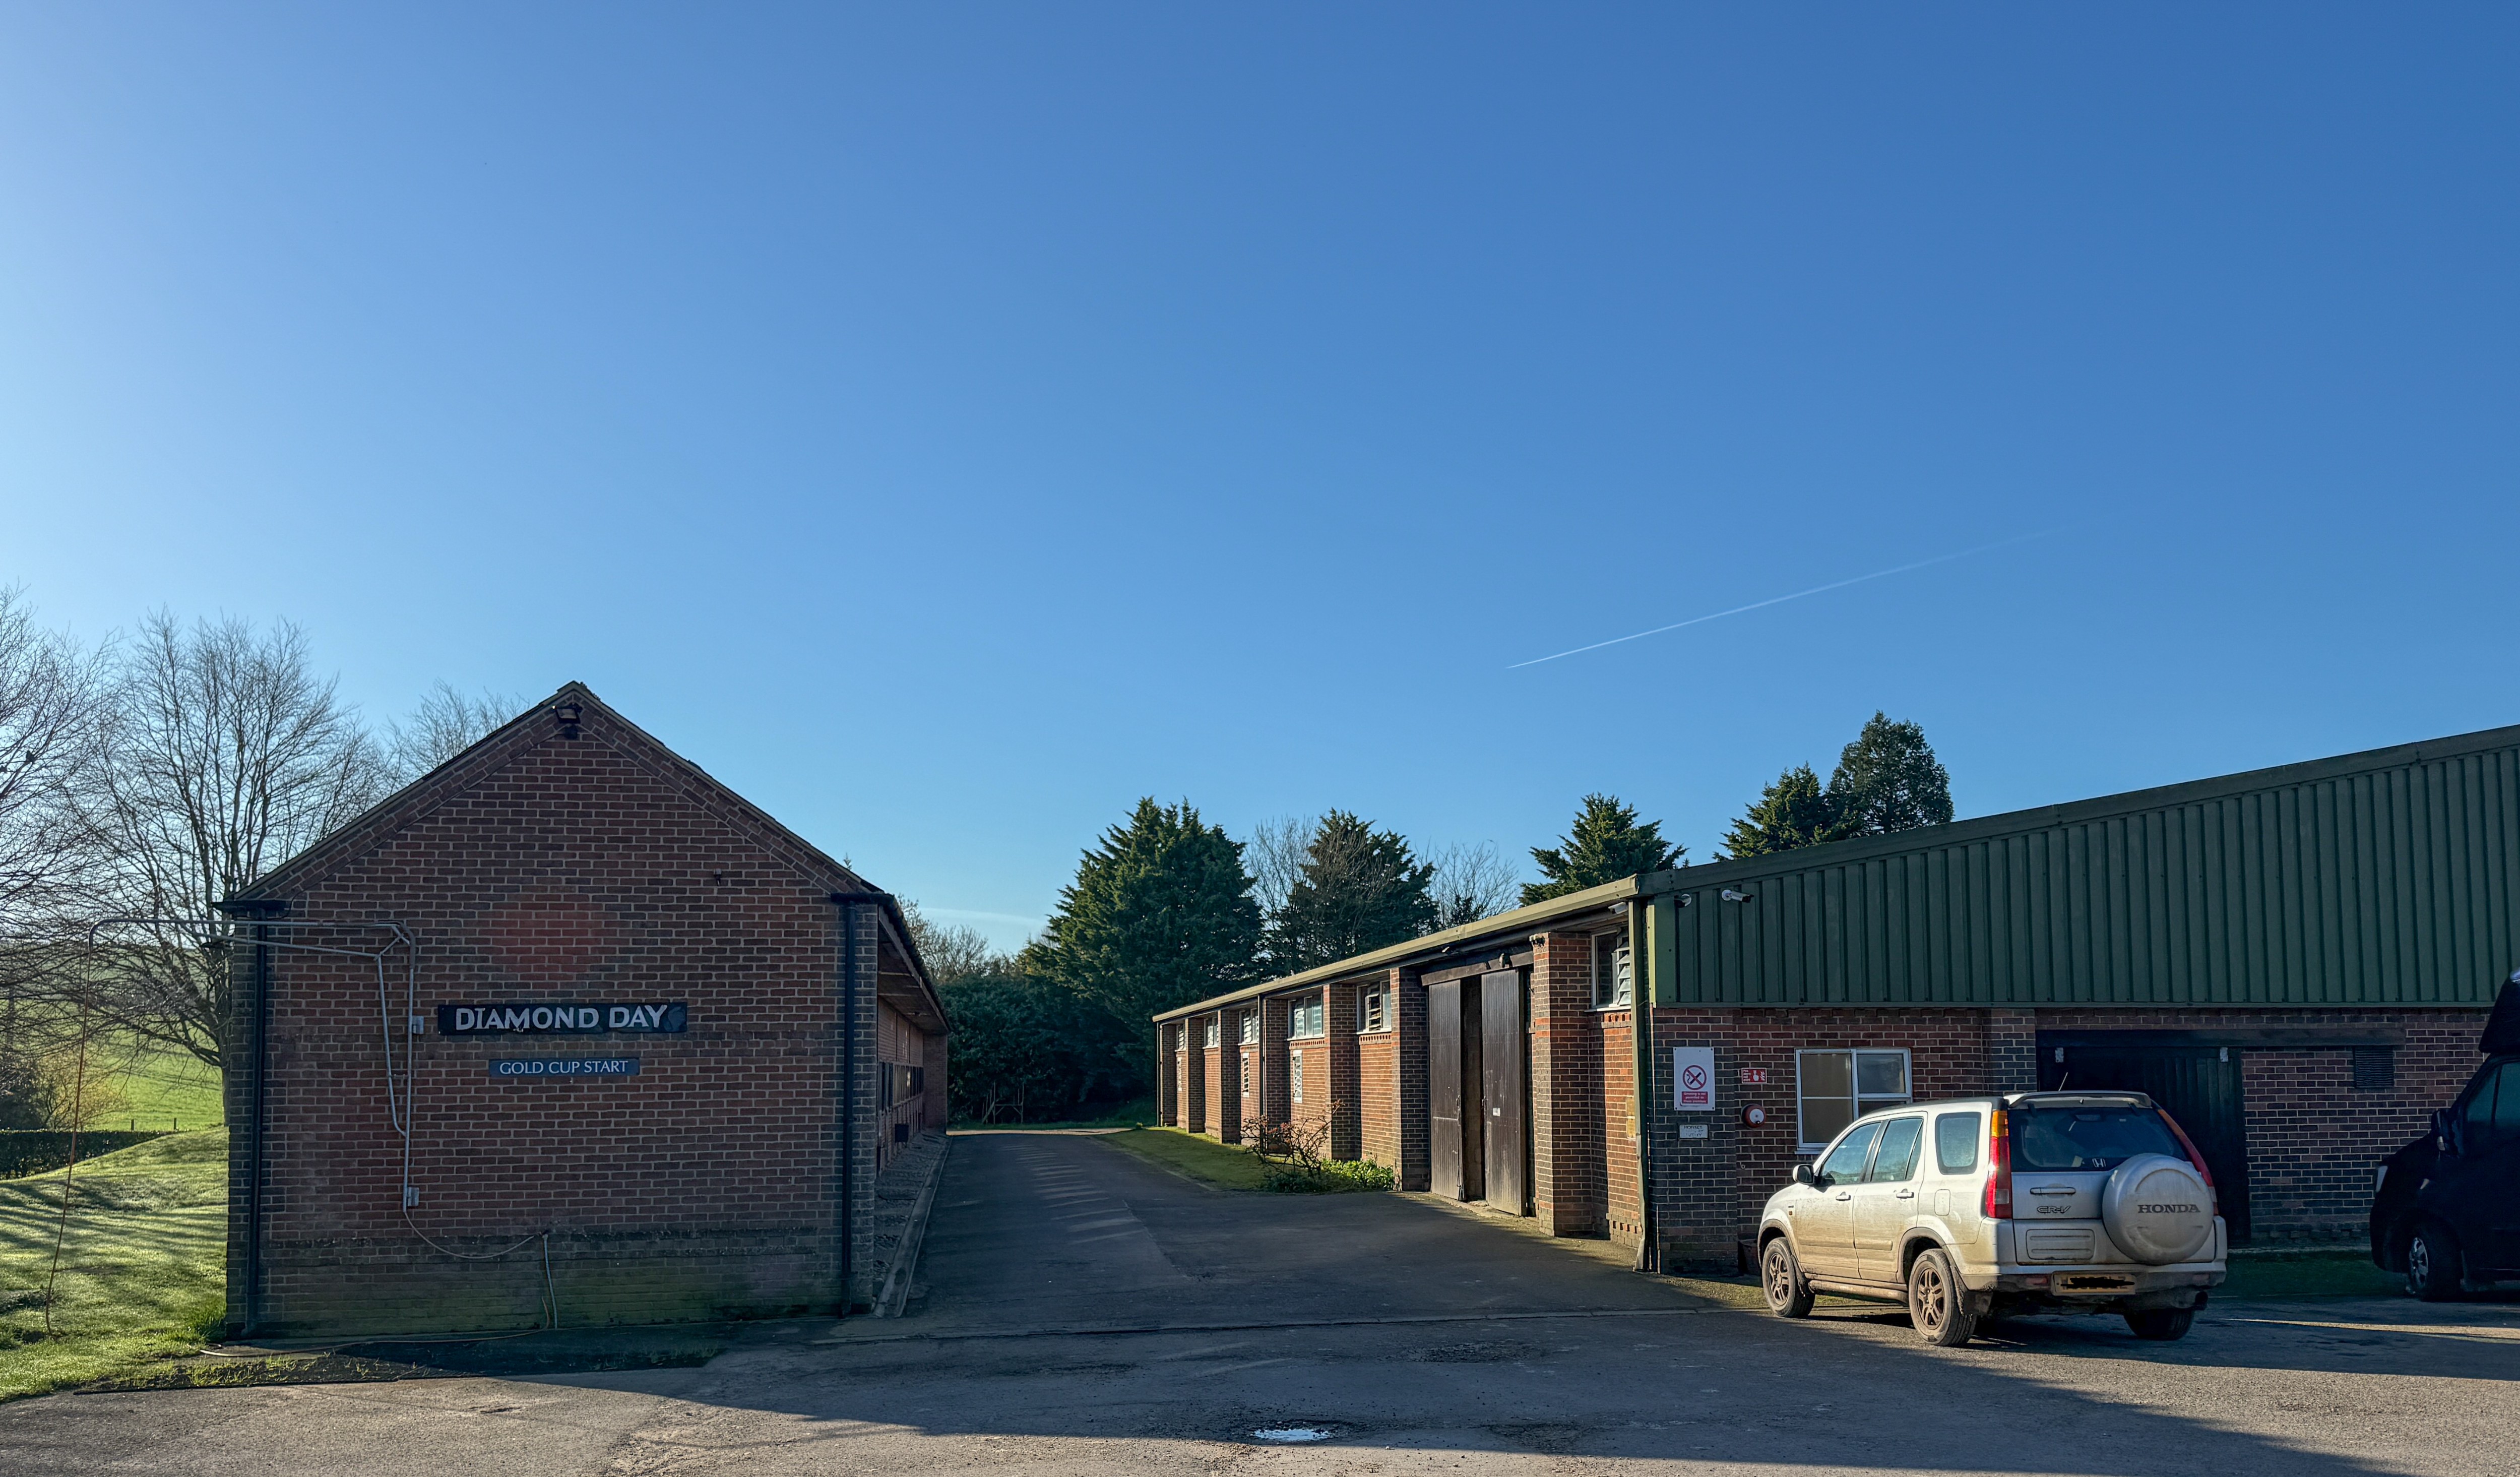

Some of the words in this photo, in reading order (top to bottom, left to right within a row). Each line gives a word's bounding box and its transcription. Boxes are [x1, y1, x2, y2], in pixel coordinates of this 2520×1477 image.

[456, 1007, 600, 1030] DIAMOND
[608, 1004, 668, 1028] DAY
[499, 1062, 544, 1074] GOLD
[548, 1061, 580, 1073] CUP
[584, 1060, 628, 1073] START
[2037, 1205, 2071, 1214] CR-V
[2137, 1204, 2201, 1213] HONDA
